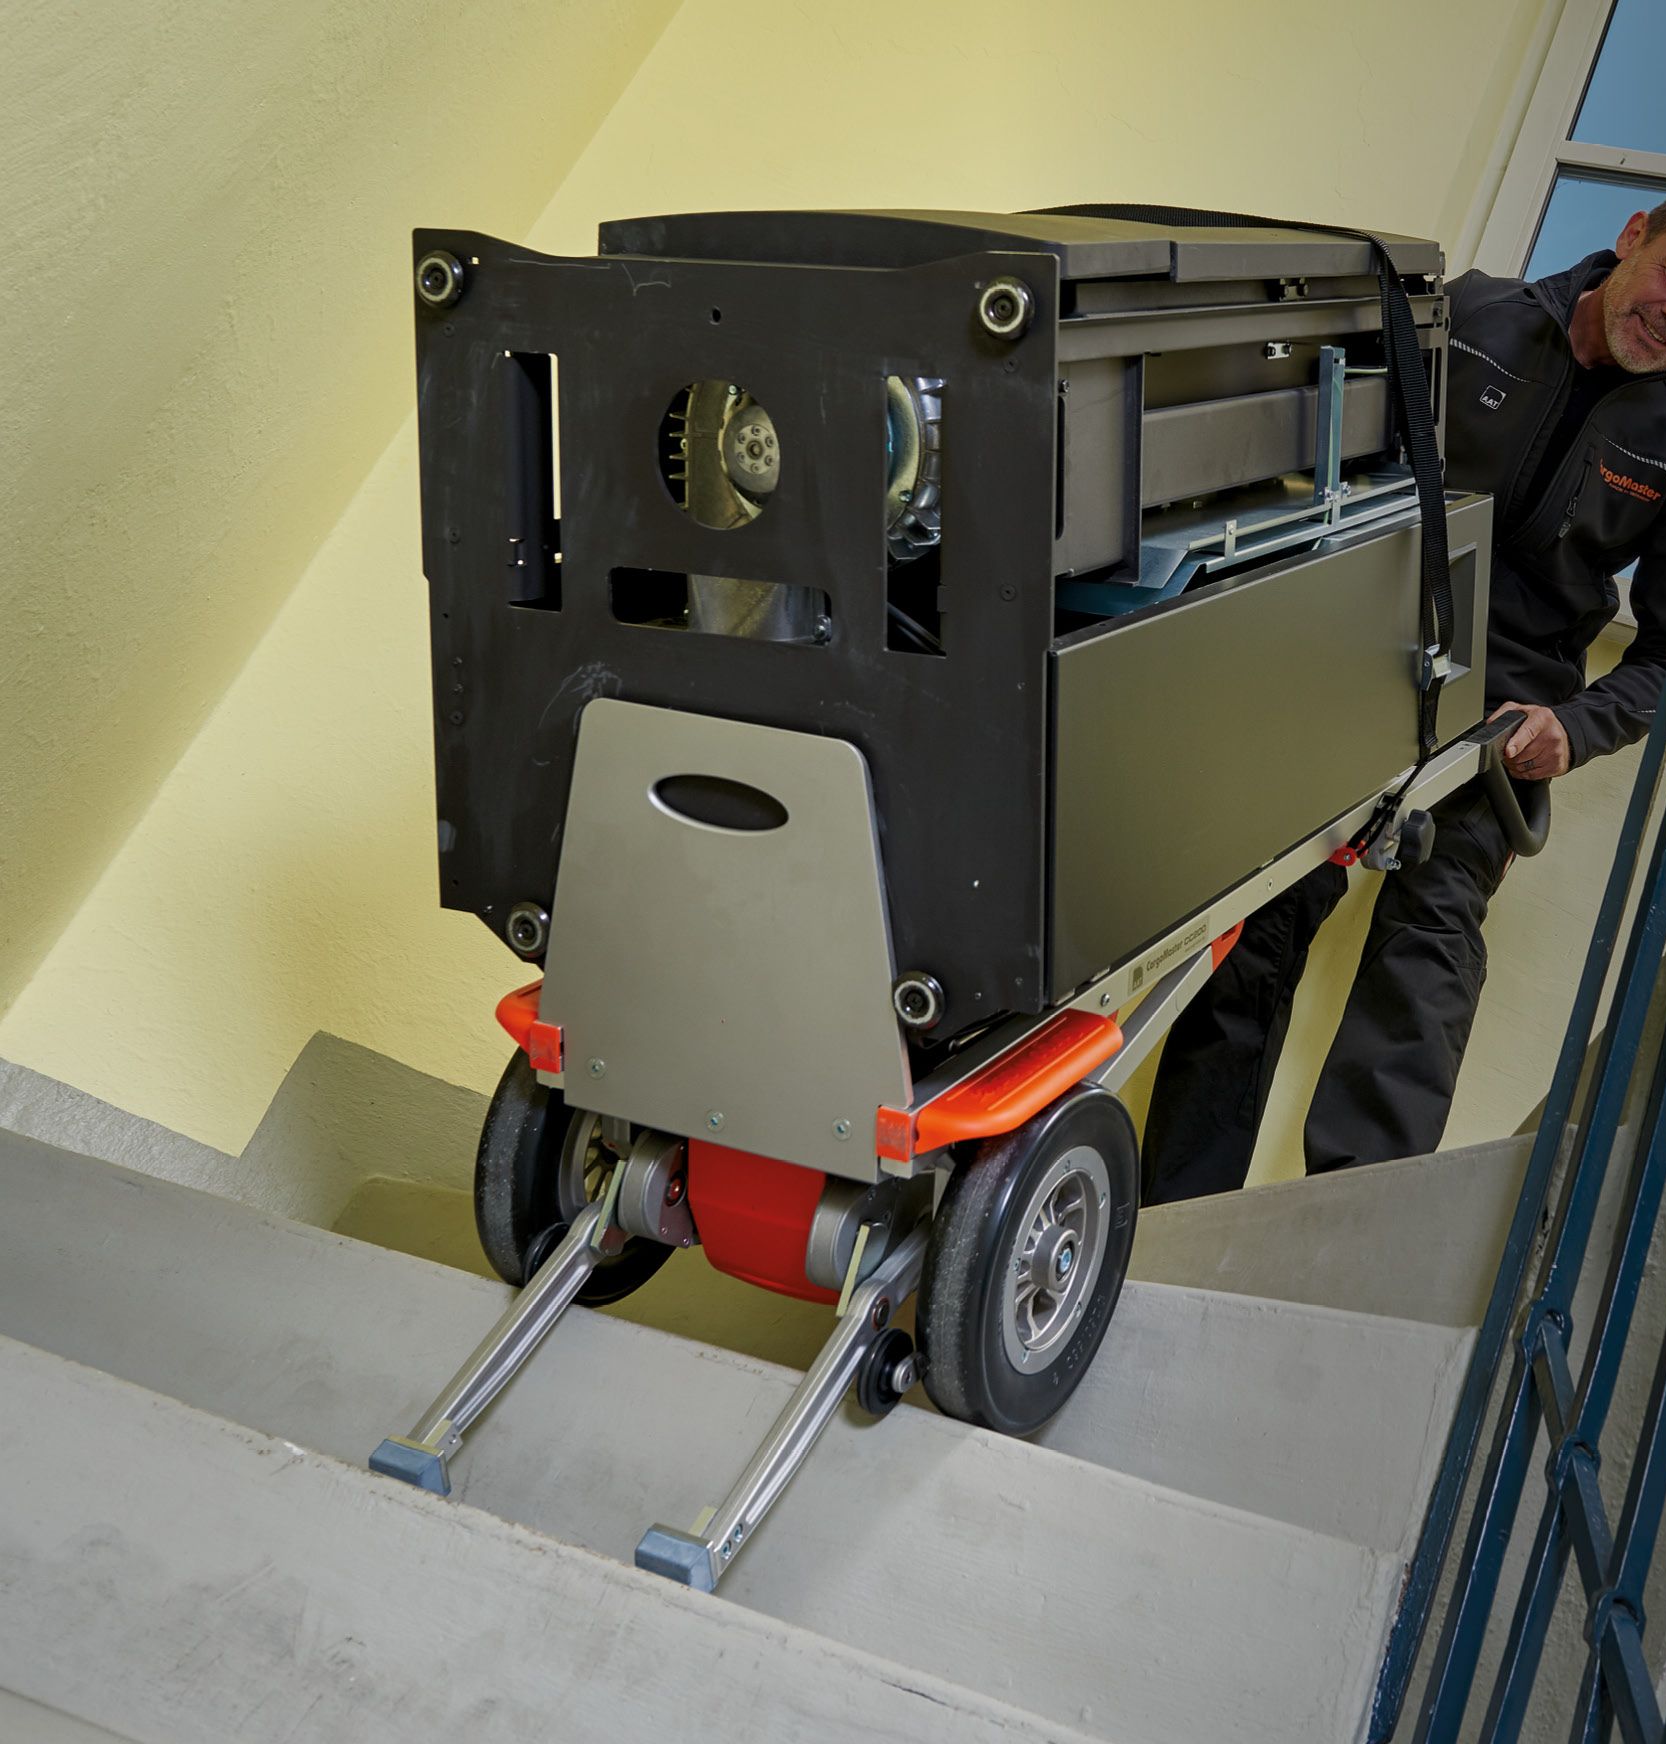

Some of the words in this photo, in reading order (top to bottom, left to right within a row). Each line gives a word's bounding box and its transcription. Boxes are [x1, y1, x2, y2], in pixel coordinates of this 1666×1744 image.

[1481, 395, 1499, 408] AAT
[1600, 458, 1662, 501] rgoMaster
[1146, 941, 1184, 972] CargoMaster
